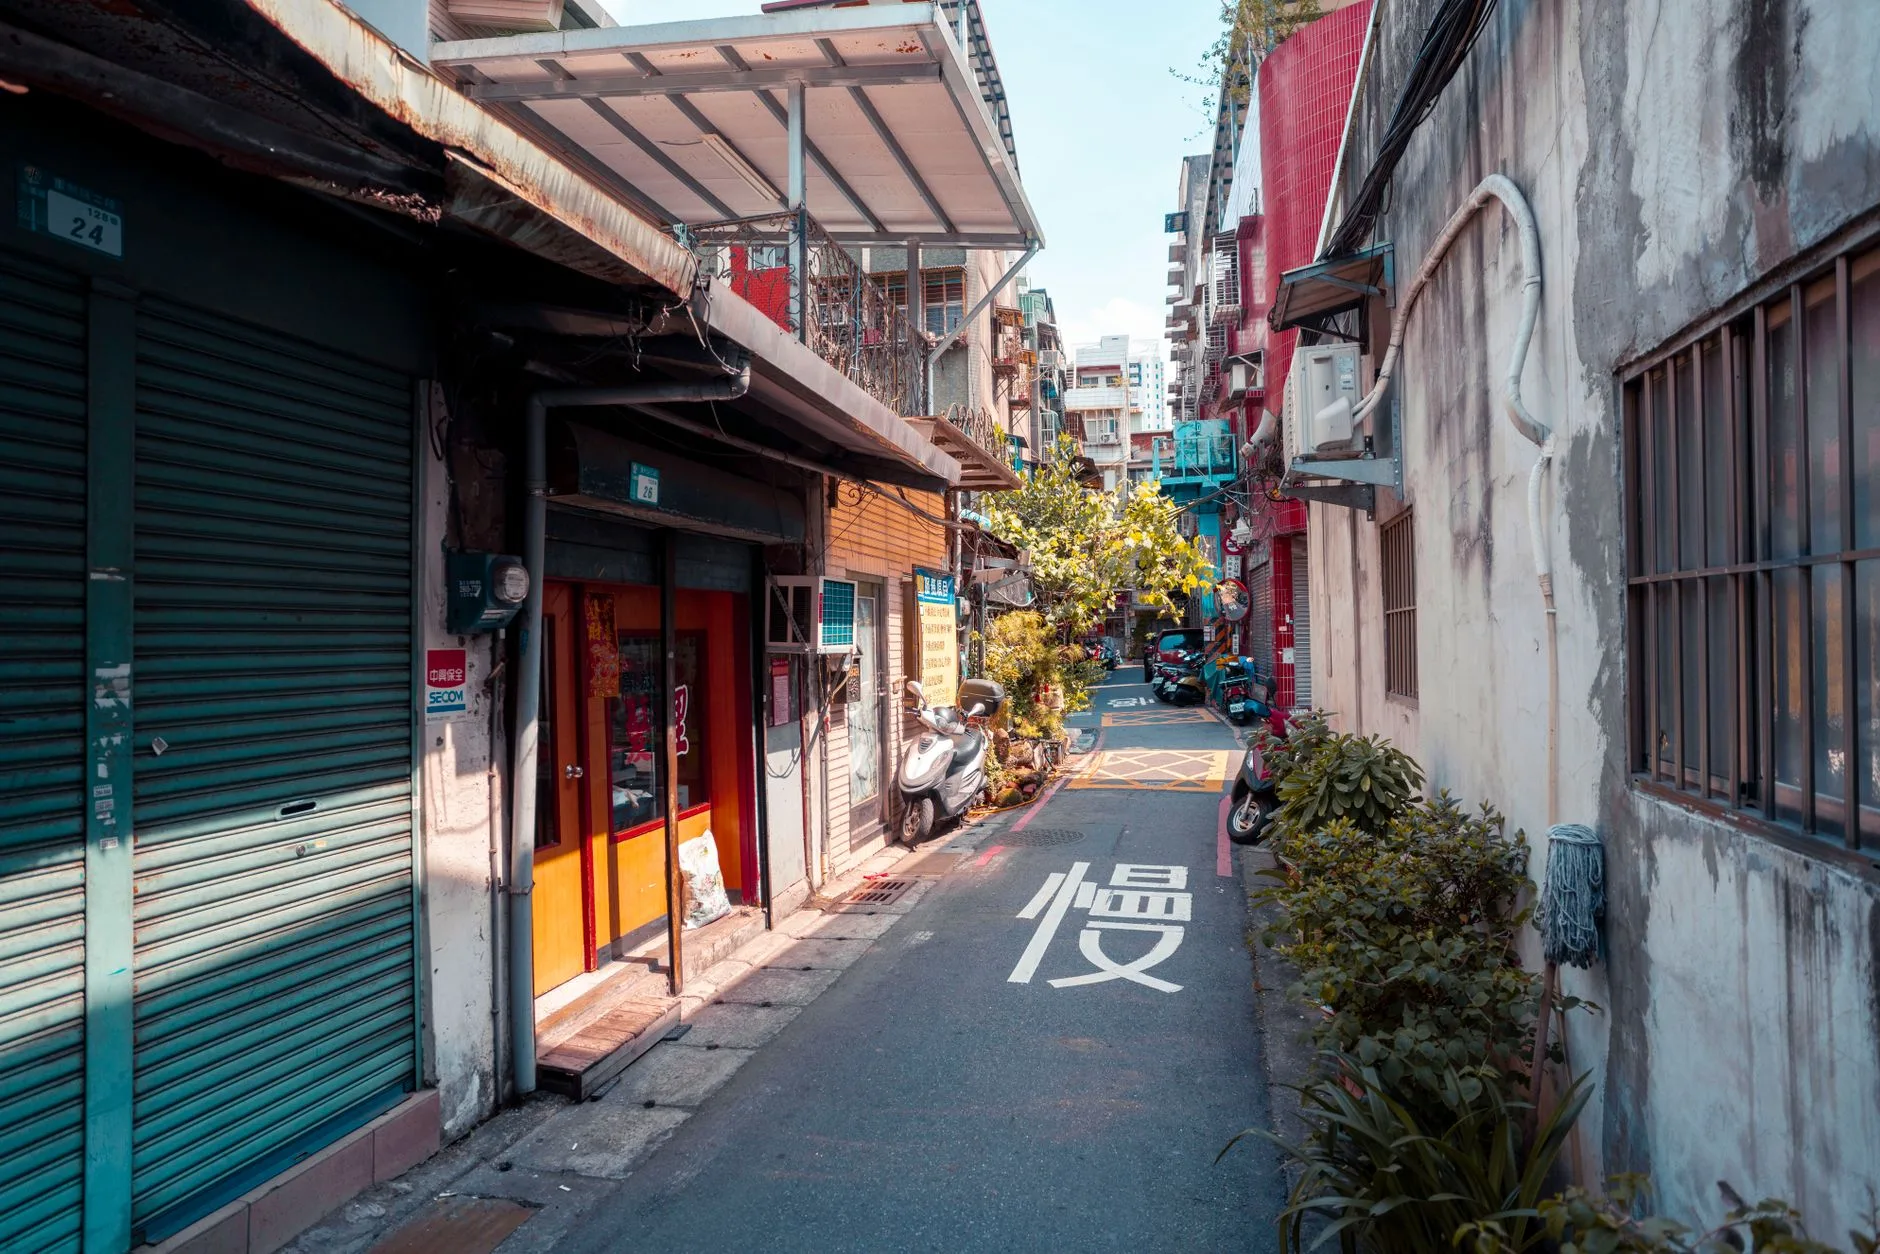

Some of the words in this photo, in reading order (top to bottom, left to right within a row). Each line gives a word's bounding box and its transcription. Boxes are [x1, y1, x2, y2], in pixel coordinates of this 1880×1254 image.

[70, 217, 104, 245] 24
[643, 485, 653, 499] 26
[429, 668, 463, 682] 中興保全
[429, 689, 463, 704] SECOM
[1007, 861, 1193, 994] 慢
